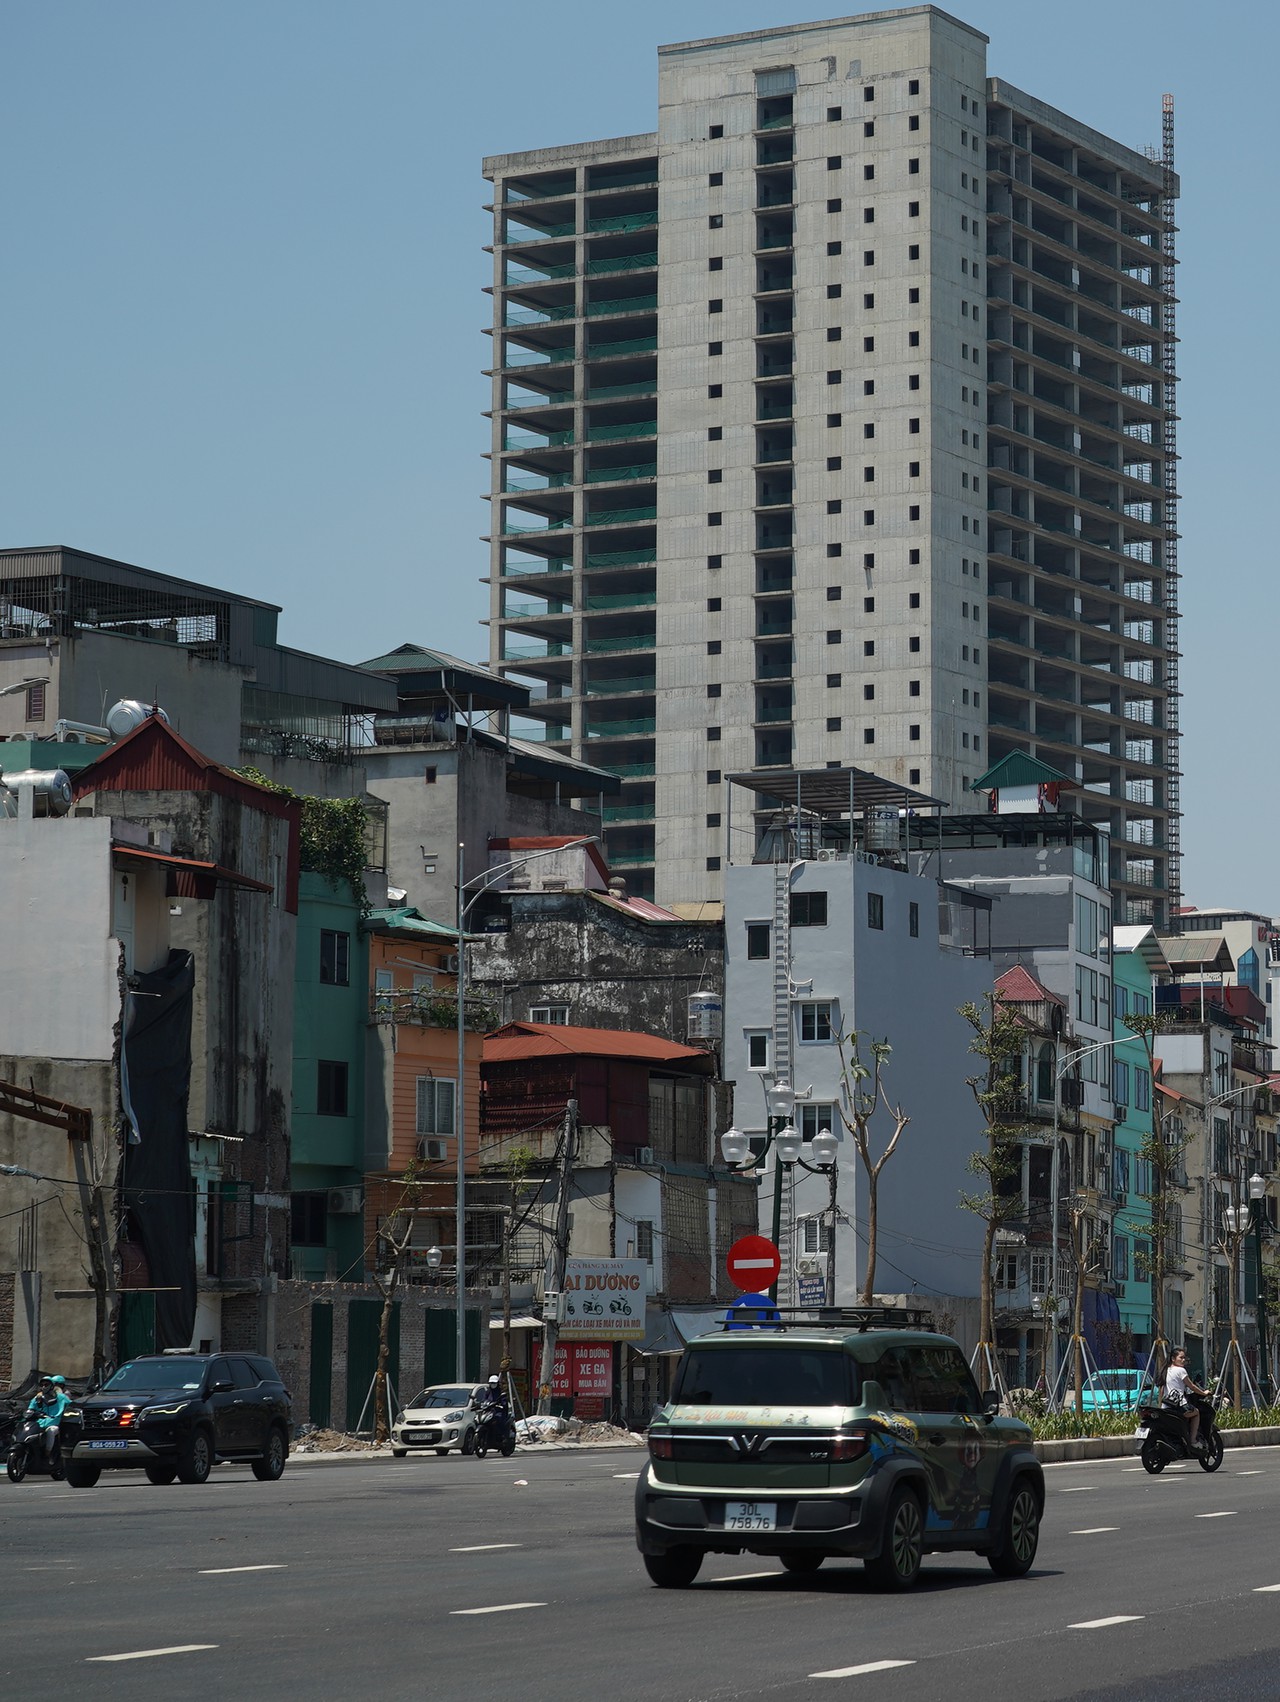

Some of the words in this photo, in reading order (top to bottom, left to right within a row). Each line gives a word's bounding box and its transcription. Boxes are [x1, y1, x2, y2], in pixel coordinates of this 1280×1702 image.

[584, 1272, 640, 1291] DƯƠNG
[575, 1346, 588, 1359] BẢO
[589, 1346, 610, 1359] DƯỠNG
[580, 1363, 591, 1375] XE
[594, 1363, 605, 1375] GA
[578, 1379, 592, 1388] MUA
[593, 1378, 606, 1388] BÁN
[740, 1504, 761, 1516] 30L
[730, 1517, 770, 1529] 758.76
